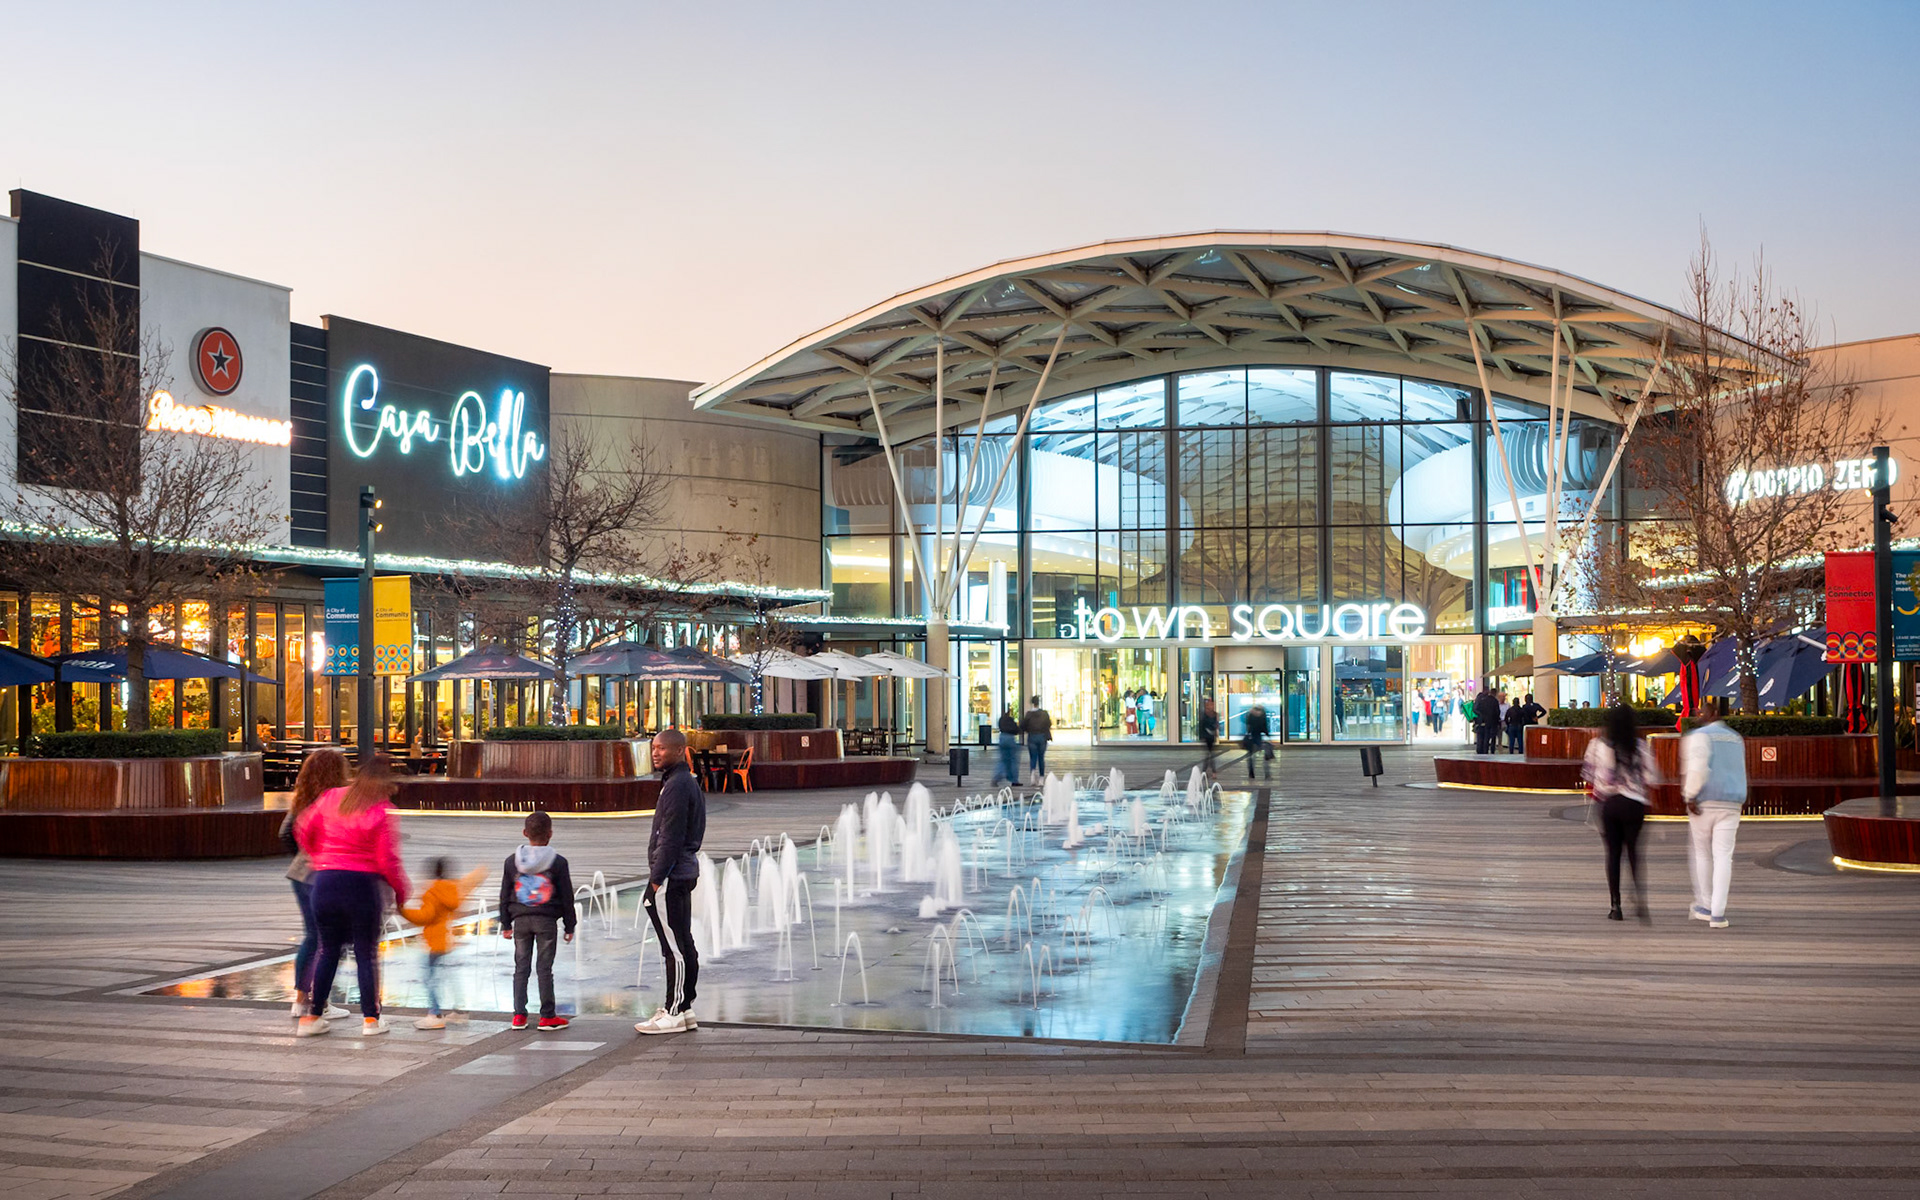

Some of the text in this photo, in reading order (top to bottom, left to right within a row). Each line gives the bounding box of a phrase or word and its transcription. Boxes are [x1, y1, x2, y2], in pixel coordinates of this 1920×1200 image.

[344, 364, 545, 480] Casa Bella
[1753, 463, 1824, 499] DOPPIO
[1074, 597, 1210, 643] town
